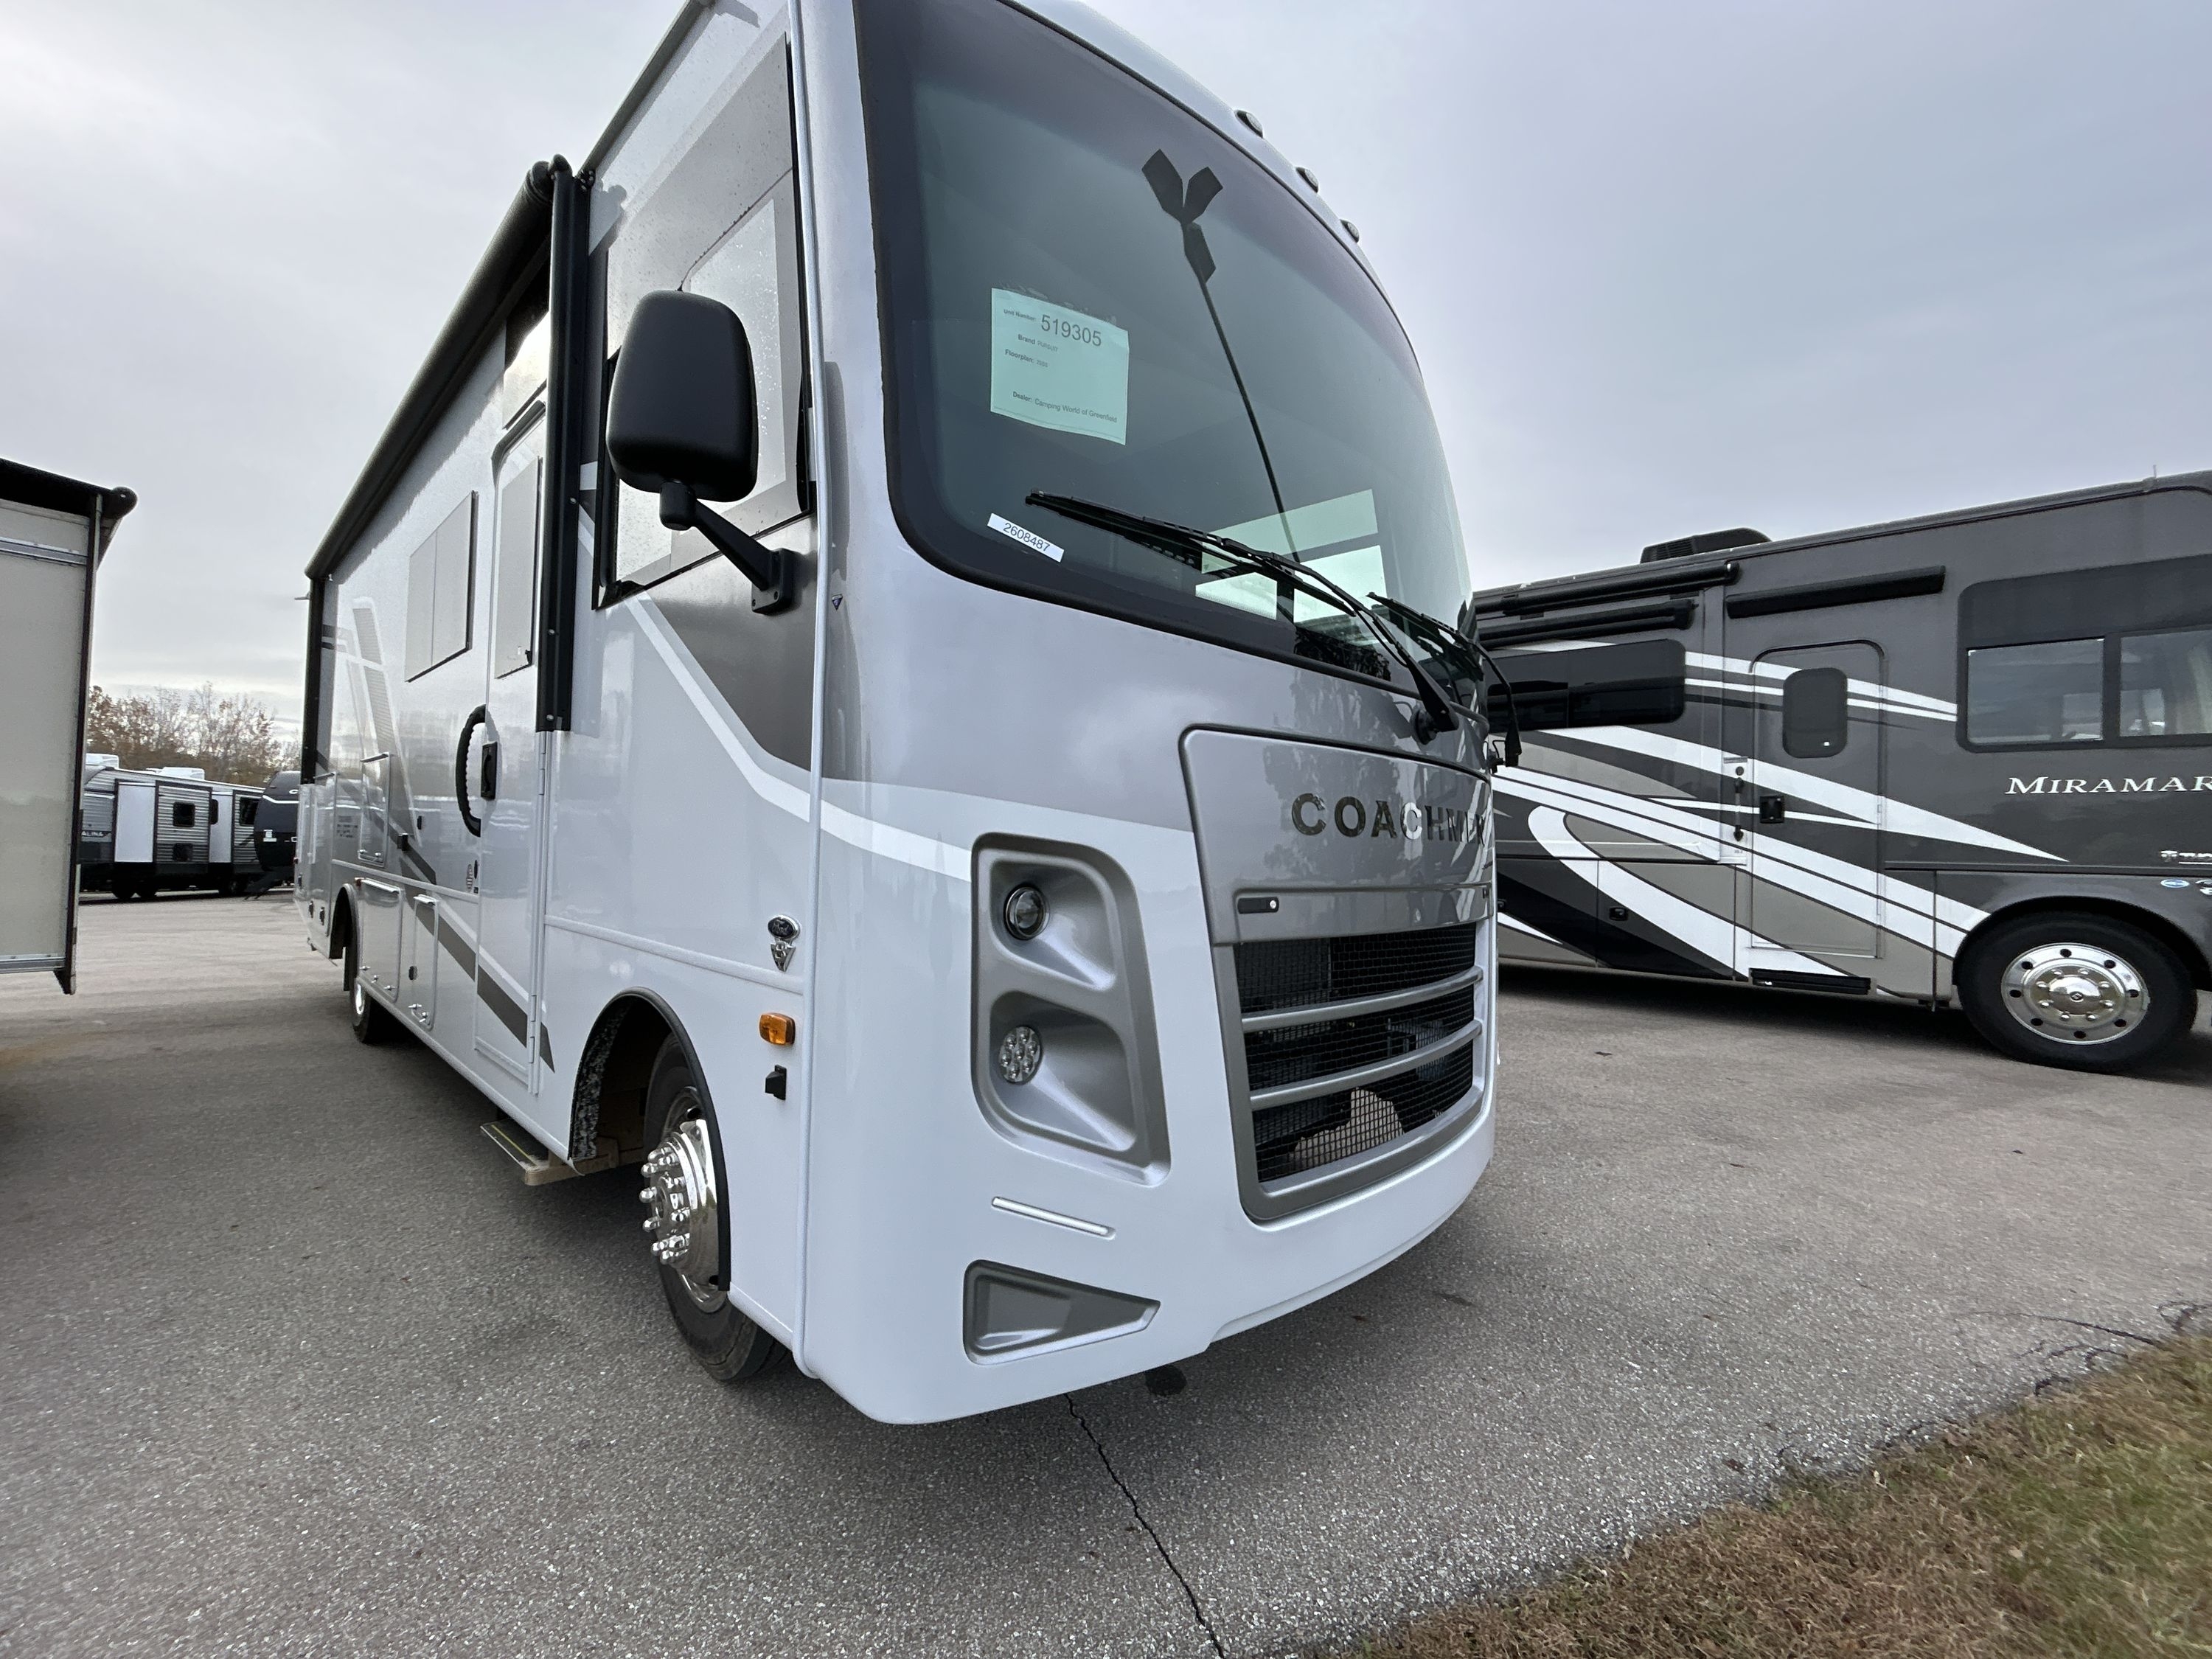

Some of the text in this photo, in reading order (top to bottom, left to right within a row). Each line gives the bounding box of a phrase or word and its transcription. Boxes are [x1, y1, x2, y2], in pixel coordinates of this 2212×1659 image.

[1041, 314, 1102, 347] 519305
[1034, 398, 1061, 412] Camping
[1062, 404, 1080, 414] World
[1088, 410, 1118, 423] Greenfield
[1003, 522, 1051, 552] 2608487
[2005, 776, 2212, 794] MIRAMAR
